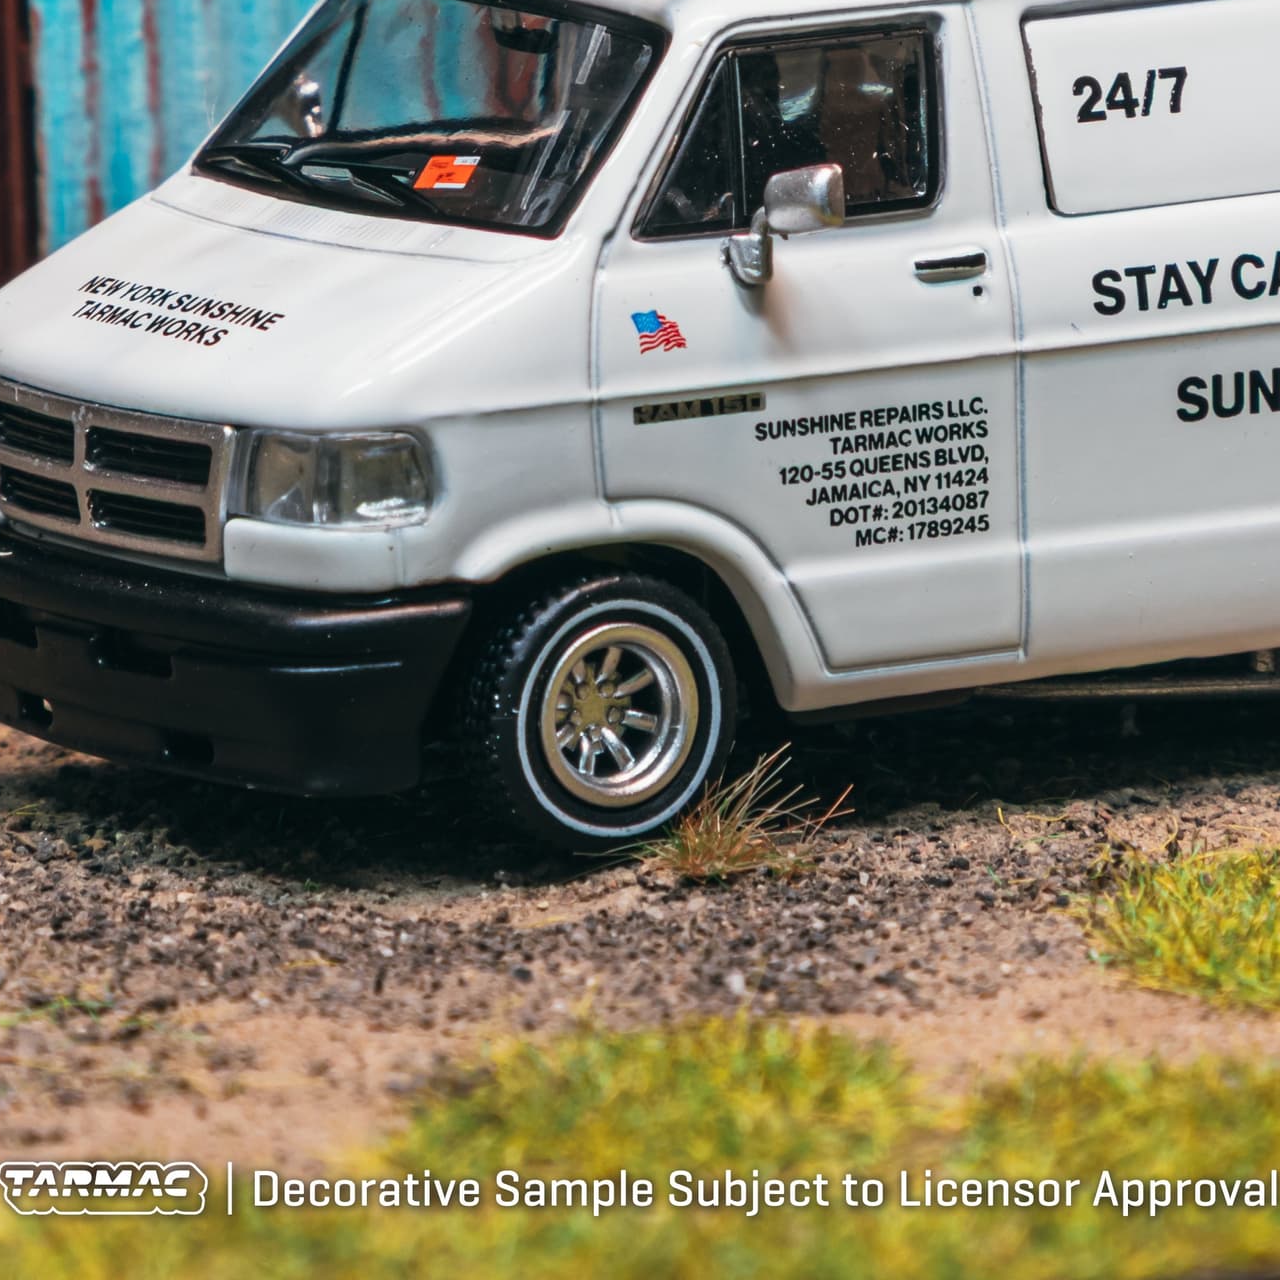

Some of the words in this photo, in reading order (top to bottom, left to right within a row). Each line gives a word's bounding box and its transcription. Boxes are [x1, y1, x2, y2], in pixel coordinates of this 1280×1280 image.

[1071, 65, 1189, 124] 24/7
[78, 275, 131, 298] NEW
[118, 283, 179, 308] YORK
[166, 293, 286, 332] SUNSHINE
[1091, 258, 1219, 317] STAY
[71, 300, 154, 329] TARMAC
[143, 314, 230, 347] WORKS
[754, 411, 857, 442] SUNSHINE
[858, 401, 945, 430] REPAIRS
[946, 396, 989, 419] LLC.
[828, 428, 913, 456] TARMAC
[913, 419, 990, 446] WORKS
[778, 460, 848, 486] 120-55
[848, 448, 933, 479] QUEENS
[934, 444, 990, 468] BLVD,
[805, 477, 902, 507] JAMAICA,
[903, 473, 931, 495] NY
[934, 466, 990, 491] 11424
[829, 503, 890, 528] DOT#:
[891, 489, 990, 520] 20134087
[854, 525, 905, 548] MC#:
[907, 513, 991, 542] 1789245
